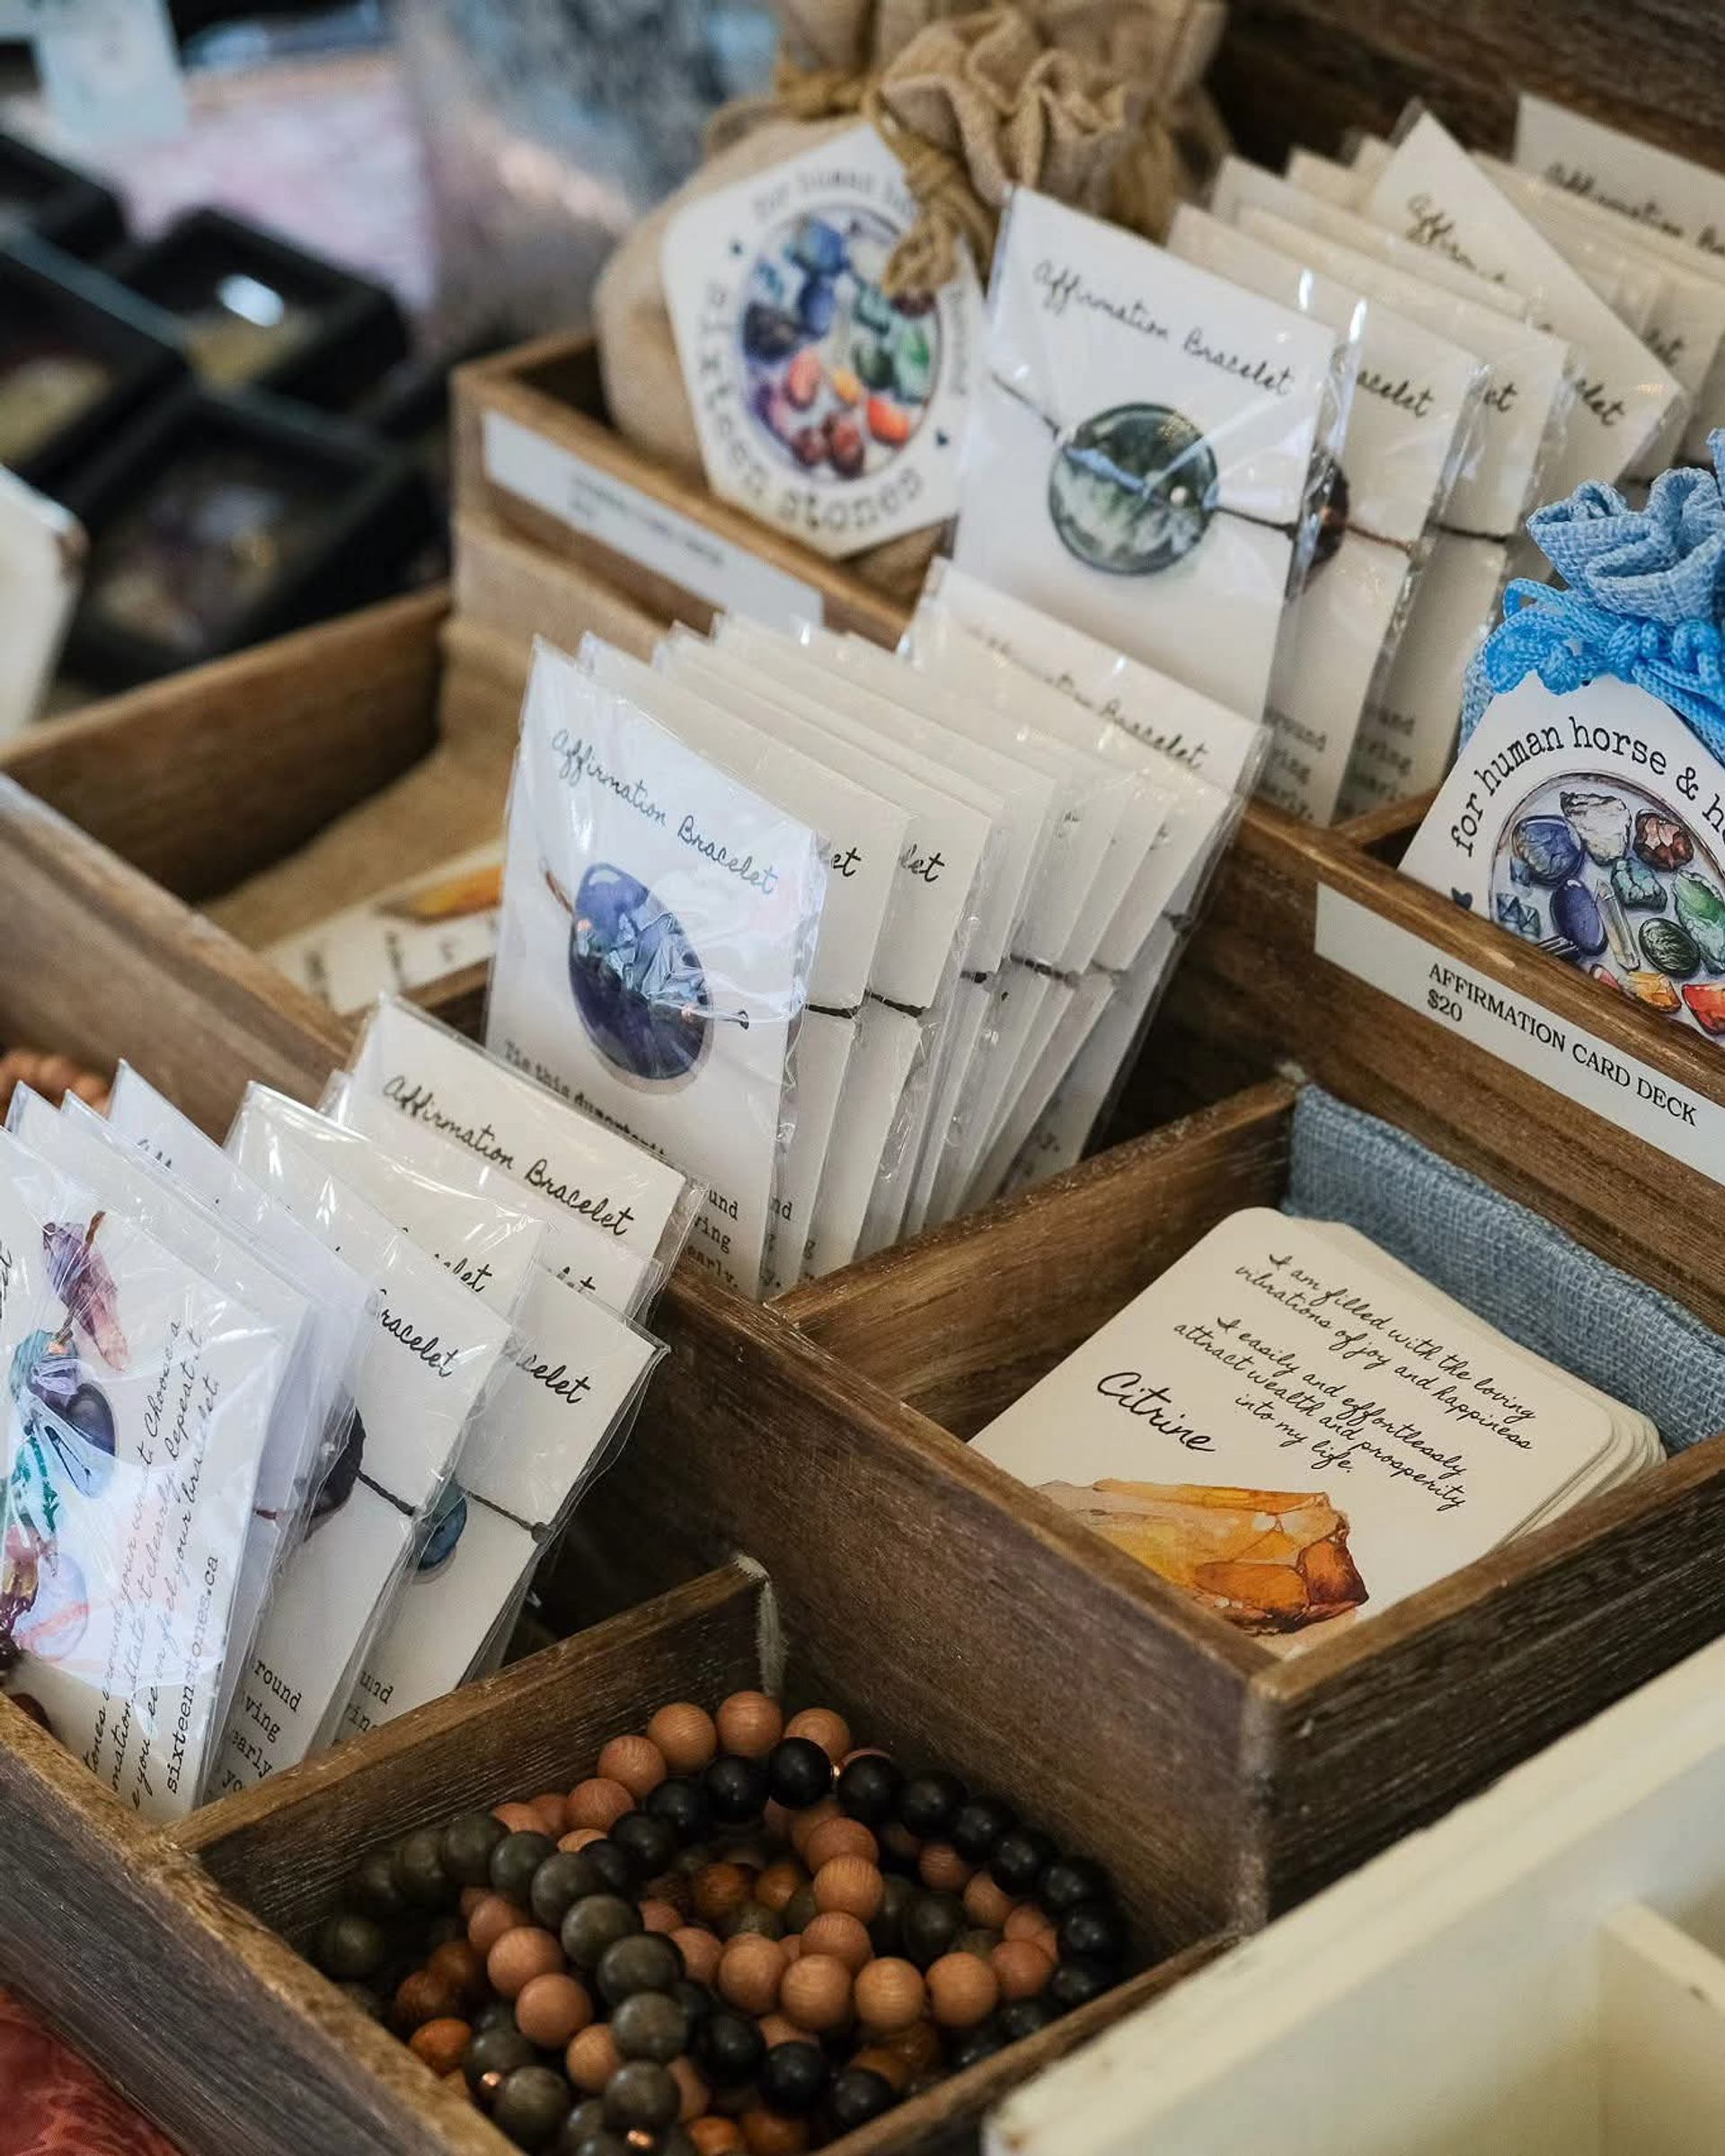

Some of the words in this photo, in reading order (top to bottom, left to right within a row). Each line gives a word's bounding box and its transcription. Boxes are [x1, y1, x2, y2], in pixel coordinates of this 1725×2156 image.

[1181, 326, 1296, 395] Bracelet
[1355, 369, 1434, 418] acelet
[551, 728, 667, 826] Affirmation
[677, 814, 779, 895] Bracelet
[1450, 792, 1484, 858] for
[1473, 726, 1565, 798] human
[1568, 715, 1668, 776] horse
[1676, 765, 1700, 801] &
[1427, 988, 1464, 1023] $20
[1429, 962, 1567, 1053] AFFIRMATION
[1572, 1043, 1632, 1088] CARD
[1637, 1075, 1698, 1127] DECK
[382, 1074, 516, 1171] Affirmation
[523, 1157, 635, 1237] Bracelet
[1234, 1266, 1332, 1330] vibrations
[1269, 1252, 1294, 1272] I
[1289, 1268, 1321, 1291] am
[1309, 1287, 1394, 1330] filled
[1387, 1329, 1445, 1362] with
[1438, 1354, 1473, 1381] the
[1473, 1377, 1537, 1425] loving
[1328, 1330, 1368, 1352] of
[1341, 1340, 1393, 1371] joy
[1393, 1365, 1439, 1391] and
[144, 1346, 173, 1439] Choose
[164, 1360, 196, 1462] Repeat
[1097, 1372, 1216, 1453] Citrine
[1173, 1324, 1256, 1372] attract
[1246, 1370, 1326, 1418] wealth
[1319, 1416, 1365, 1441] and
[1347, 1441, 1466, 1513] prosperity
[1216, 1316, 1243, 1335] I
[1238, 1332, 1301, 1378] easily
[1302, 1373, 1348, 1398] and
[1335, 1397, 1467, 1480] effortlessly
[1430, 1384, 1534, 1450] happiness
[1234, 1393, 1277, 1421] into
[1274, 1420, 1309, 1449] my
[1310, 1439, 1353, 1474] life.
[167, 1555, 218, 1795] sixteenstones.ca
[253, 1659, 303, 1713] round
[136, 1738, 154, 1798] you
